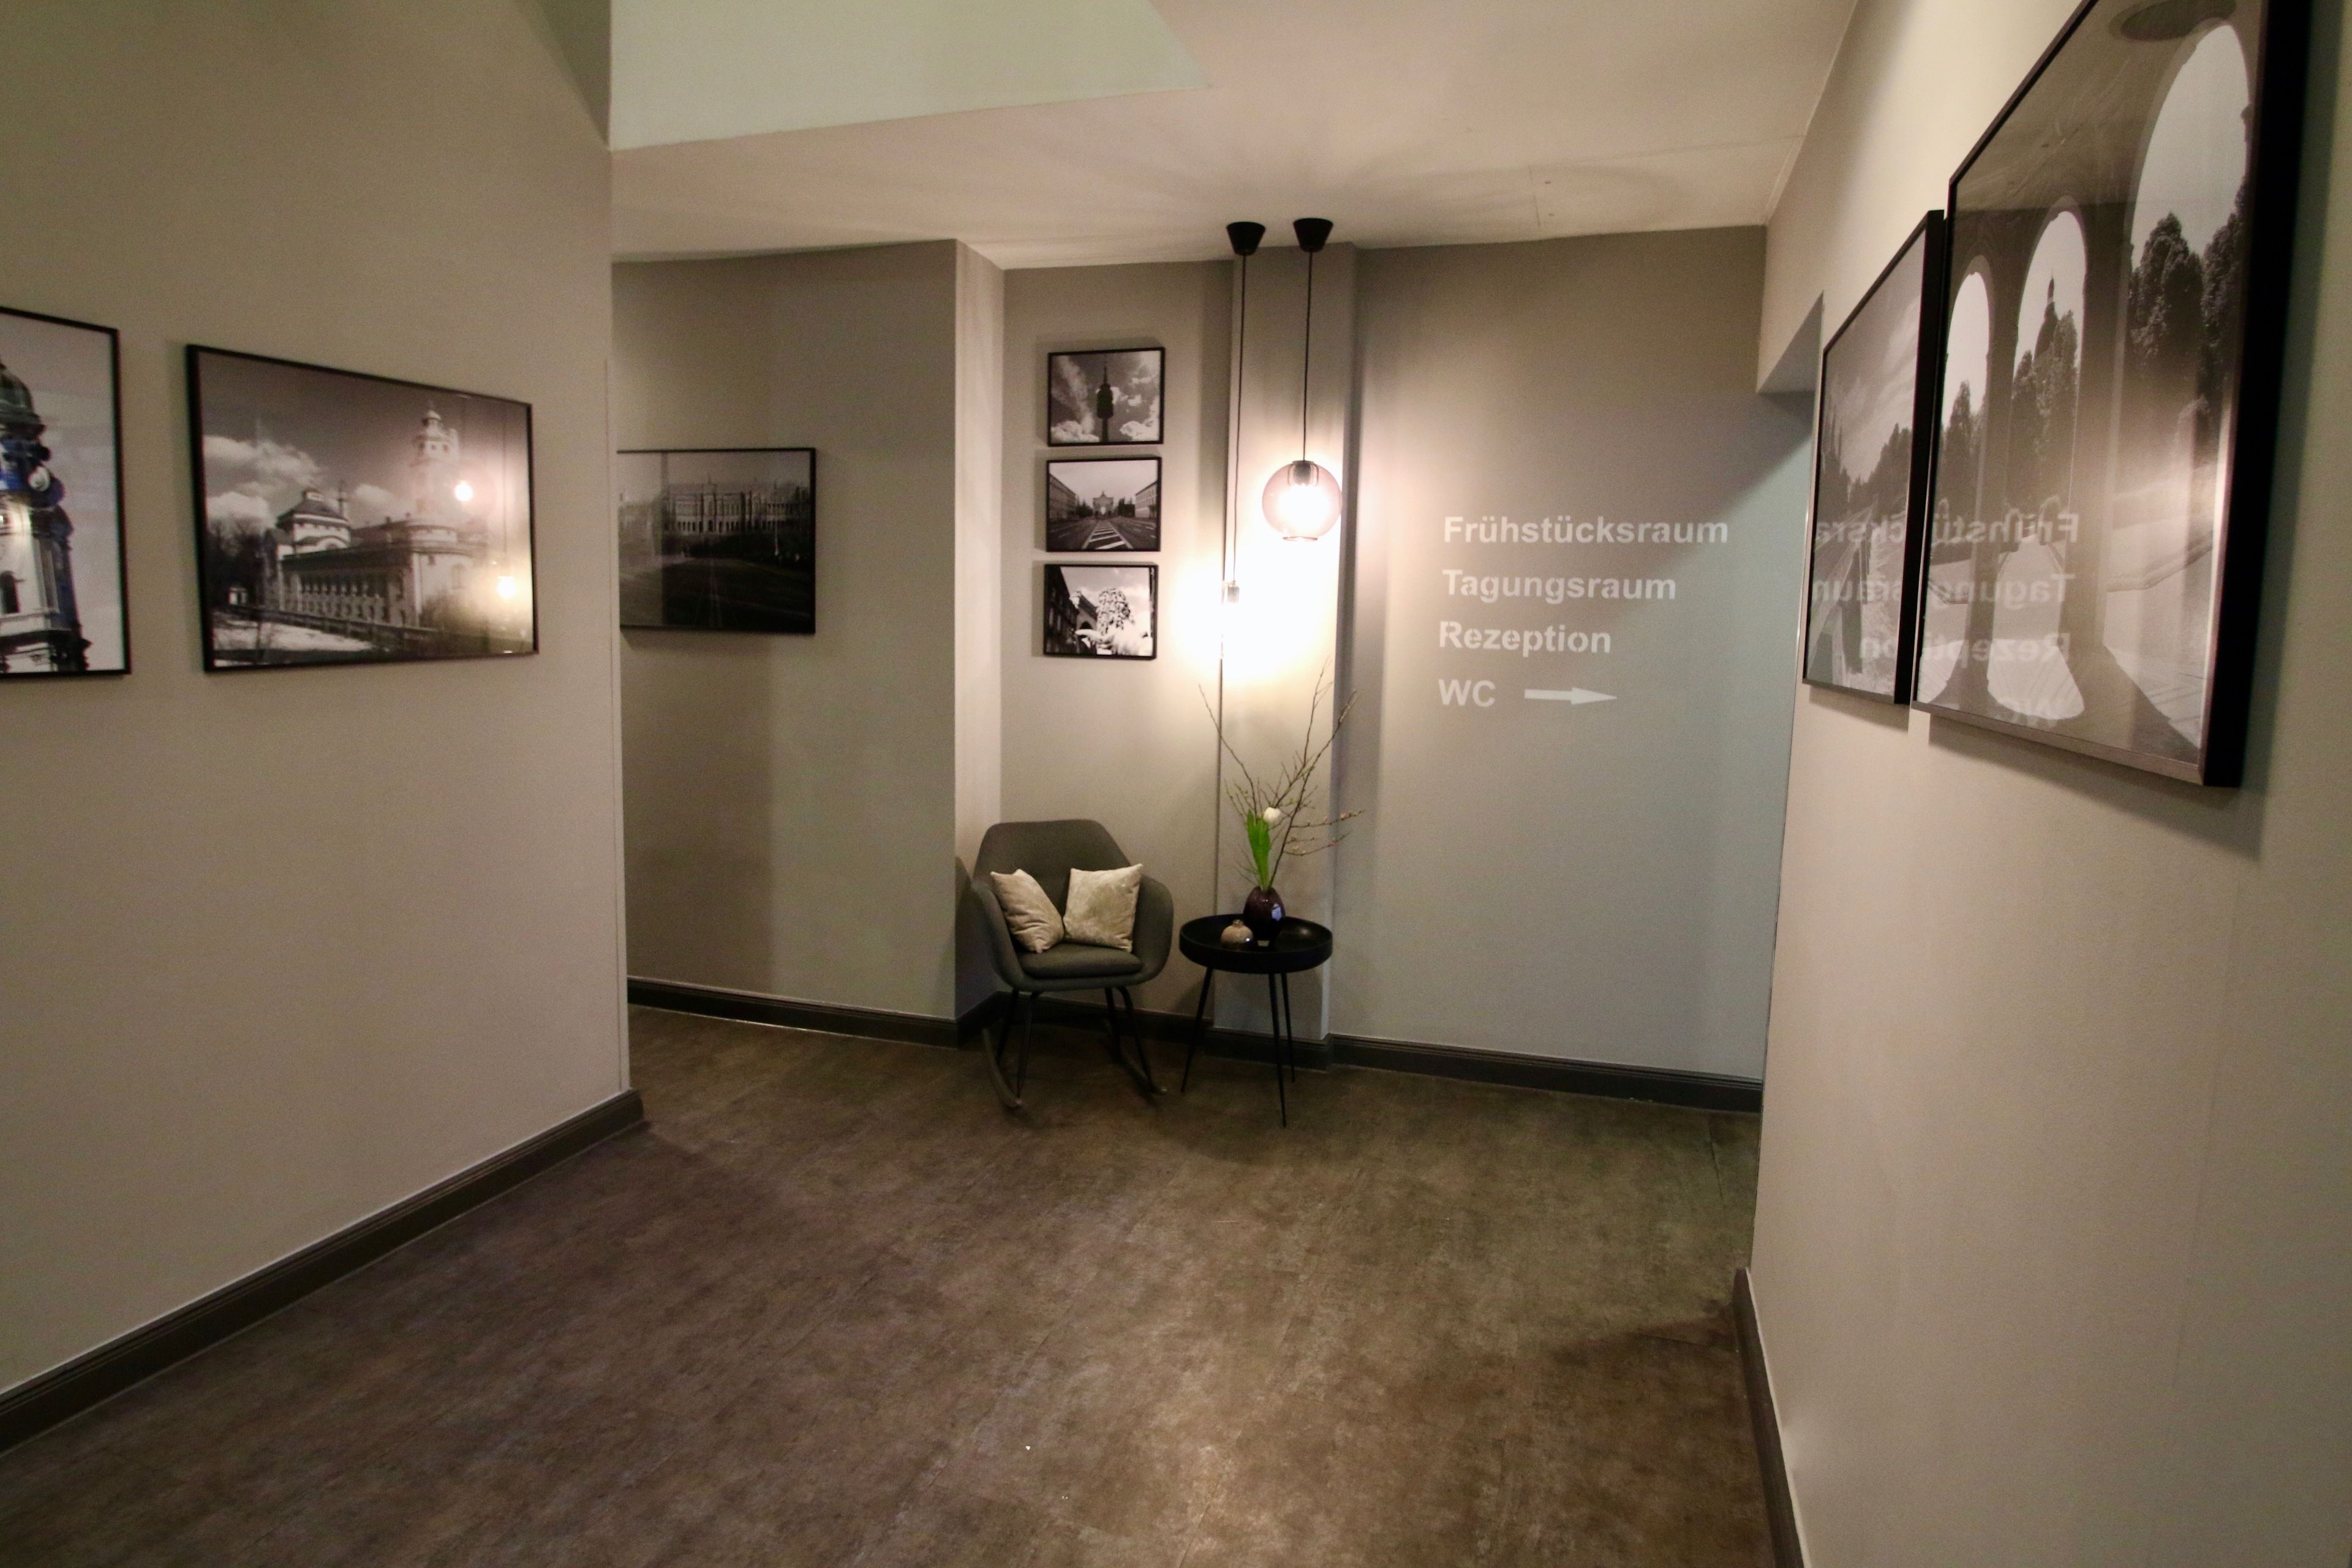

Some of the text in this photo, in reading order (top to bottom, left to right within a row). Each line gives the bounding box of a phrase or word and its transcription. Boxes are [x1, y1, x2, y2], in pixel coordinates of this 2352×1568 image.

[1444, 516, 1728, 543] Frühstücksraum
[1442, 569, 1676, 604] Tagungsraum
[1439, 621, 1611, 657] Rezeption
[1438, 679, 1496, 707] WC
